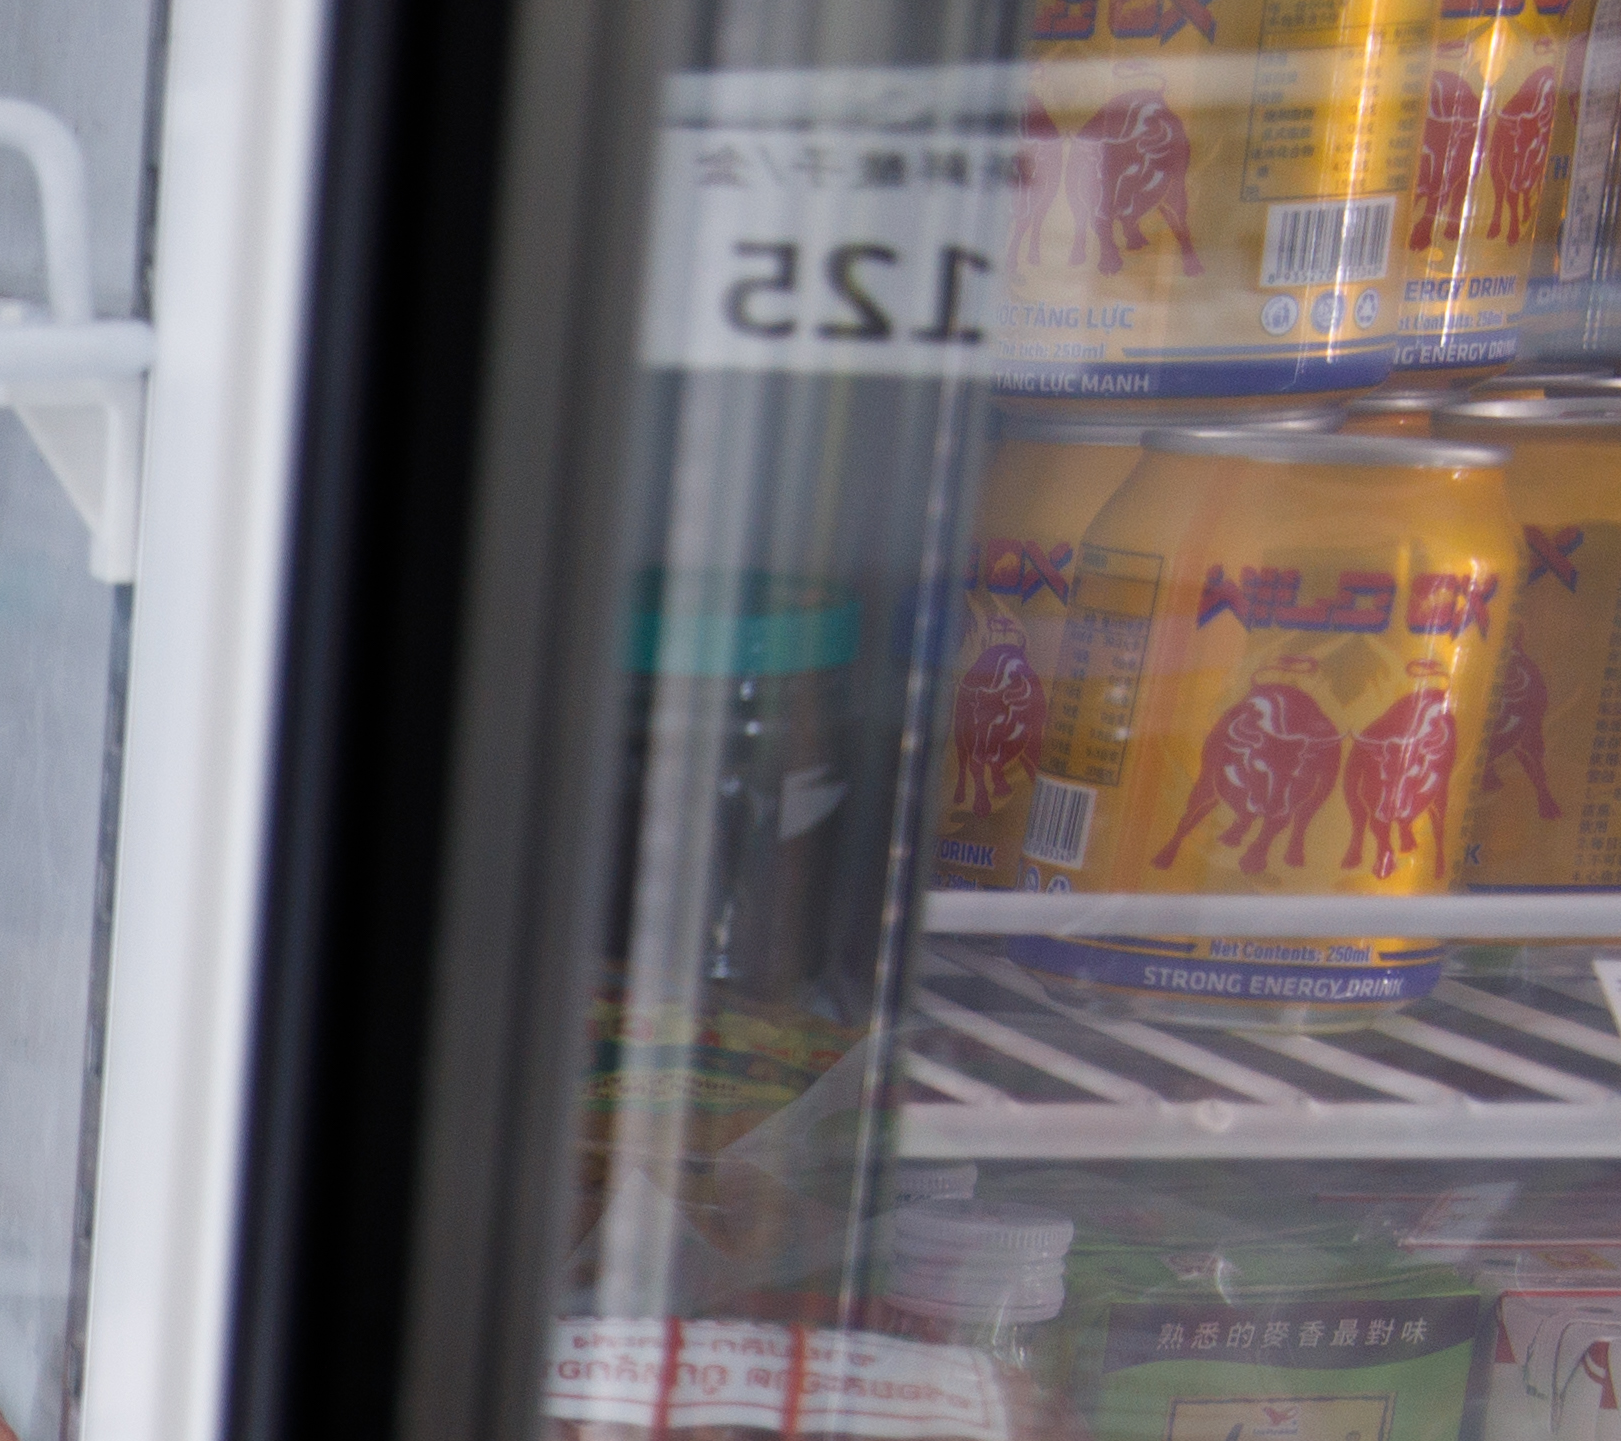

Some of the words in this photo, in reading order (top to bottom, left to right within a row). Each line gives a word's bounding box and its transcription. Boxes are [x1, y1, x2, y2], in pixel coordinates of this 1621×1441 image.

[1403, 279, 1463, 301] ERGY
[1467, 275, 1517, 299] DRINK
[1418, 340, 1487, 364] ENERGY
[1197, 564, 1396, 633] WILD
[1406, 571, 1499, 640] OX
[940, 839, 997, 869] DRINK
[1326, 944, 1373, 965] 250ml
[1143, 966, 1242, 995] STRONG
[1248, 974, 1342, 1000] ENERGY
[1343, 976, 1404, 998] DRINK
[1156, 1316, 1429, 1351] 熟悉的麥香最對味
